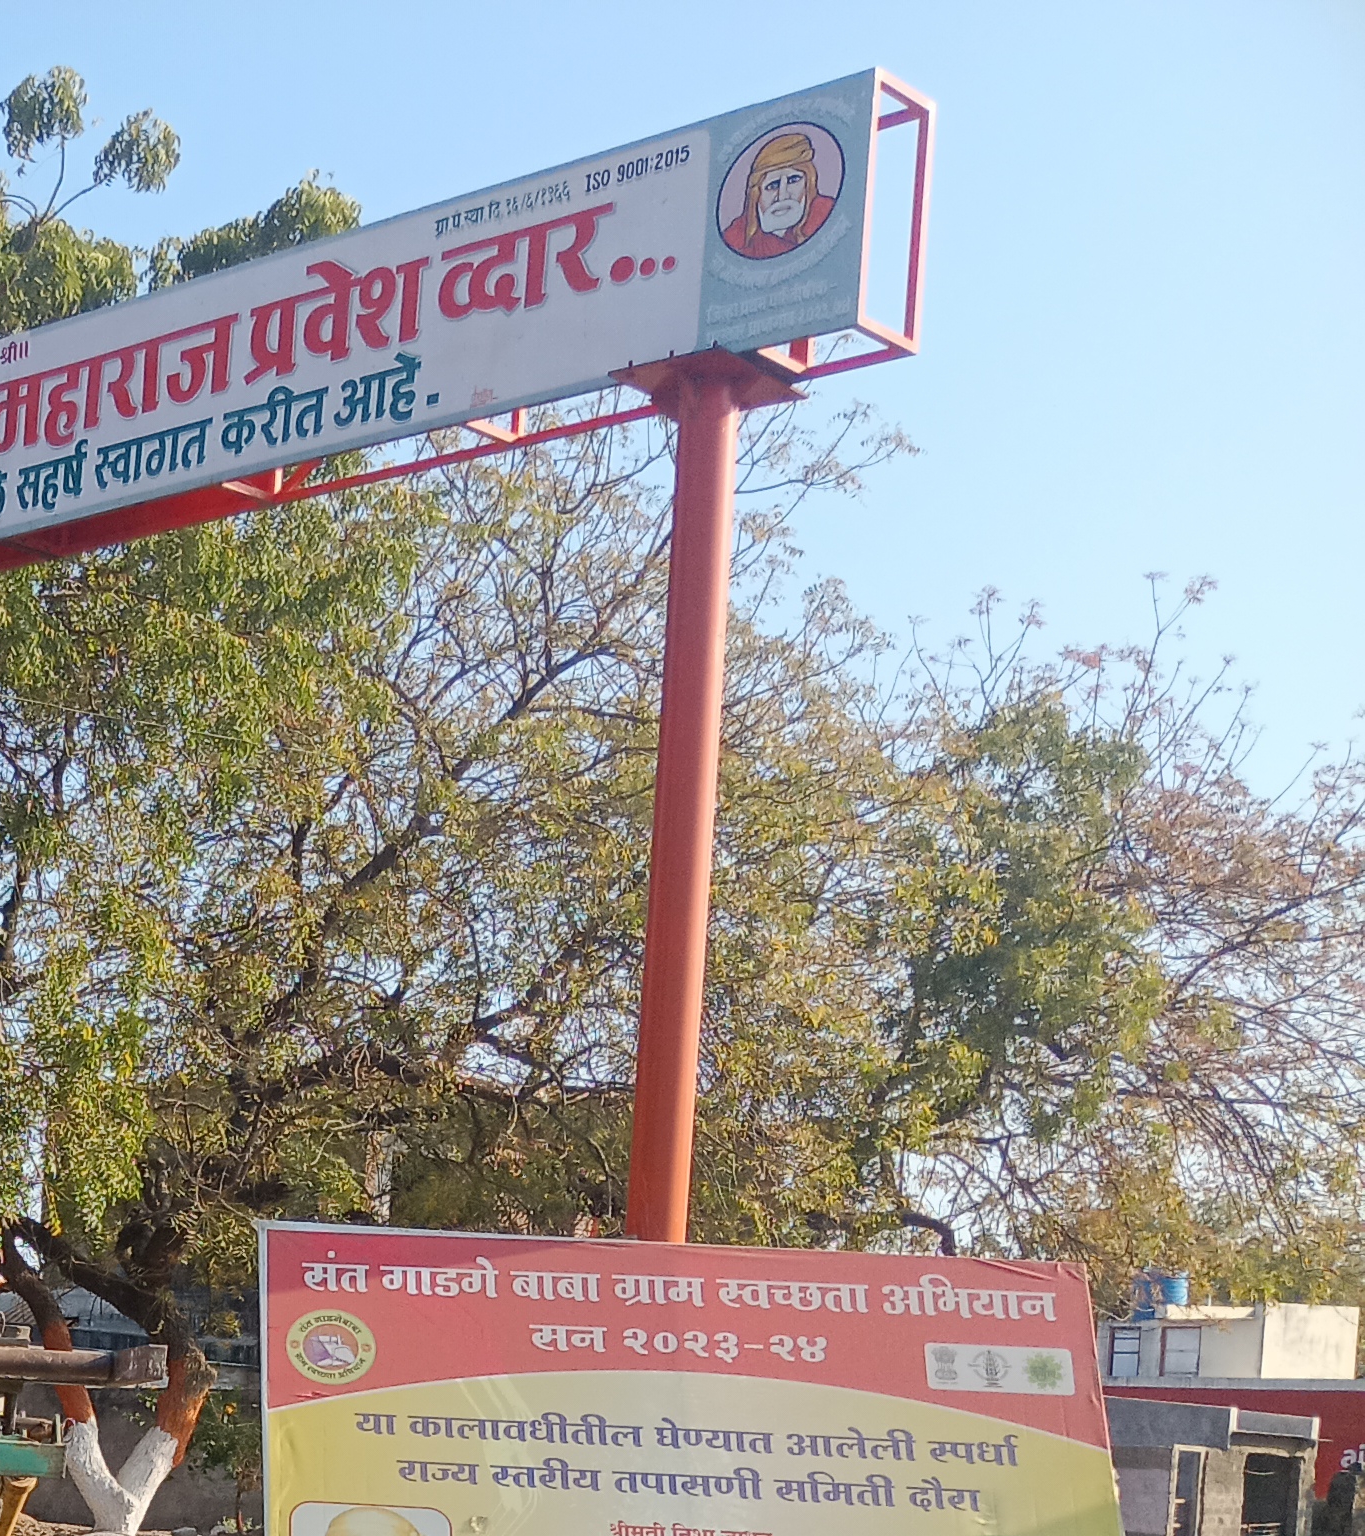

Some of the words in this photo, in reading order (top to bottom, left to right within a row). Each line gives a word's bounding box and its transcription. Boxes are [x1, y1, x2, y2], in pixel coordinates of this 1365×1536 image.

[585, 168, 611, 193] ISO
[616, 145, 691, 184] 9001:2015
[244, 259, 431, 386] प्रवेश
[16, 439, 89, 512] सहर्ष
[95, 417, 213, 490] स्वागत
[221, 385, 328, 456] करीत
[300, 1250, 371, 1294] संत
[379, 1256, 499, 1299] गाडगे
[509, 1269, 601, 1302] बाबा
[611, 1273, 706, 1308] ग्राम
[715, 1277, 870, 1315] स्वच्छता
[881, 1273, 1058, 1322] अभियान
[528, 1323, 609, 1354] सन
[622, 1327, 829, 1364] २०२३-२४
[353, 1411, 398, 1436] या
[406, 1410, 644, 1448] कालावधीतील
[654, 1416, 775, 1455] घेण्यात
[785, 1426, 918, 1463] आलेली
[927, 1434, 1021, 1467] स्पर्धा
[396, 1459, 480, 1486] राज्य
[488, 1456, 602, 1492] स्तरीय
[611, 1465, 763, 1501] तपासणी
[772, 1470, 896, 1508] समिती
[905, 1475, 981, 1513] दौरा
